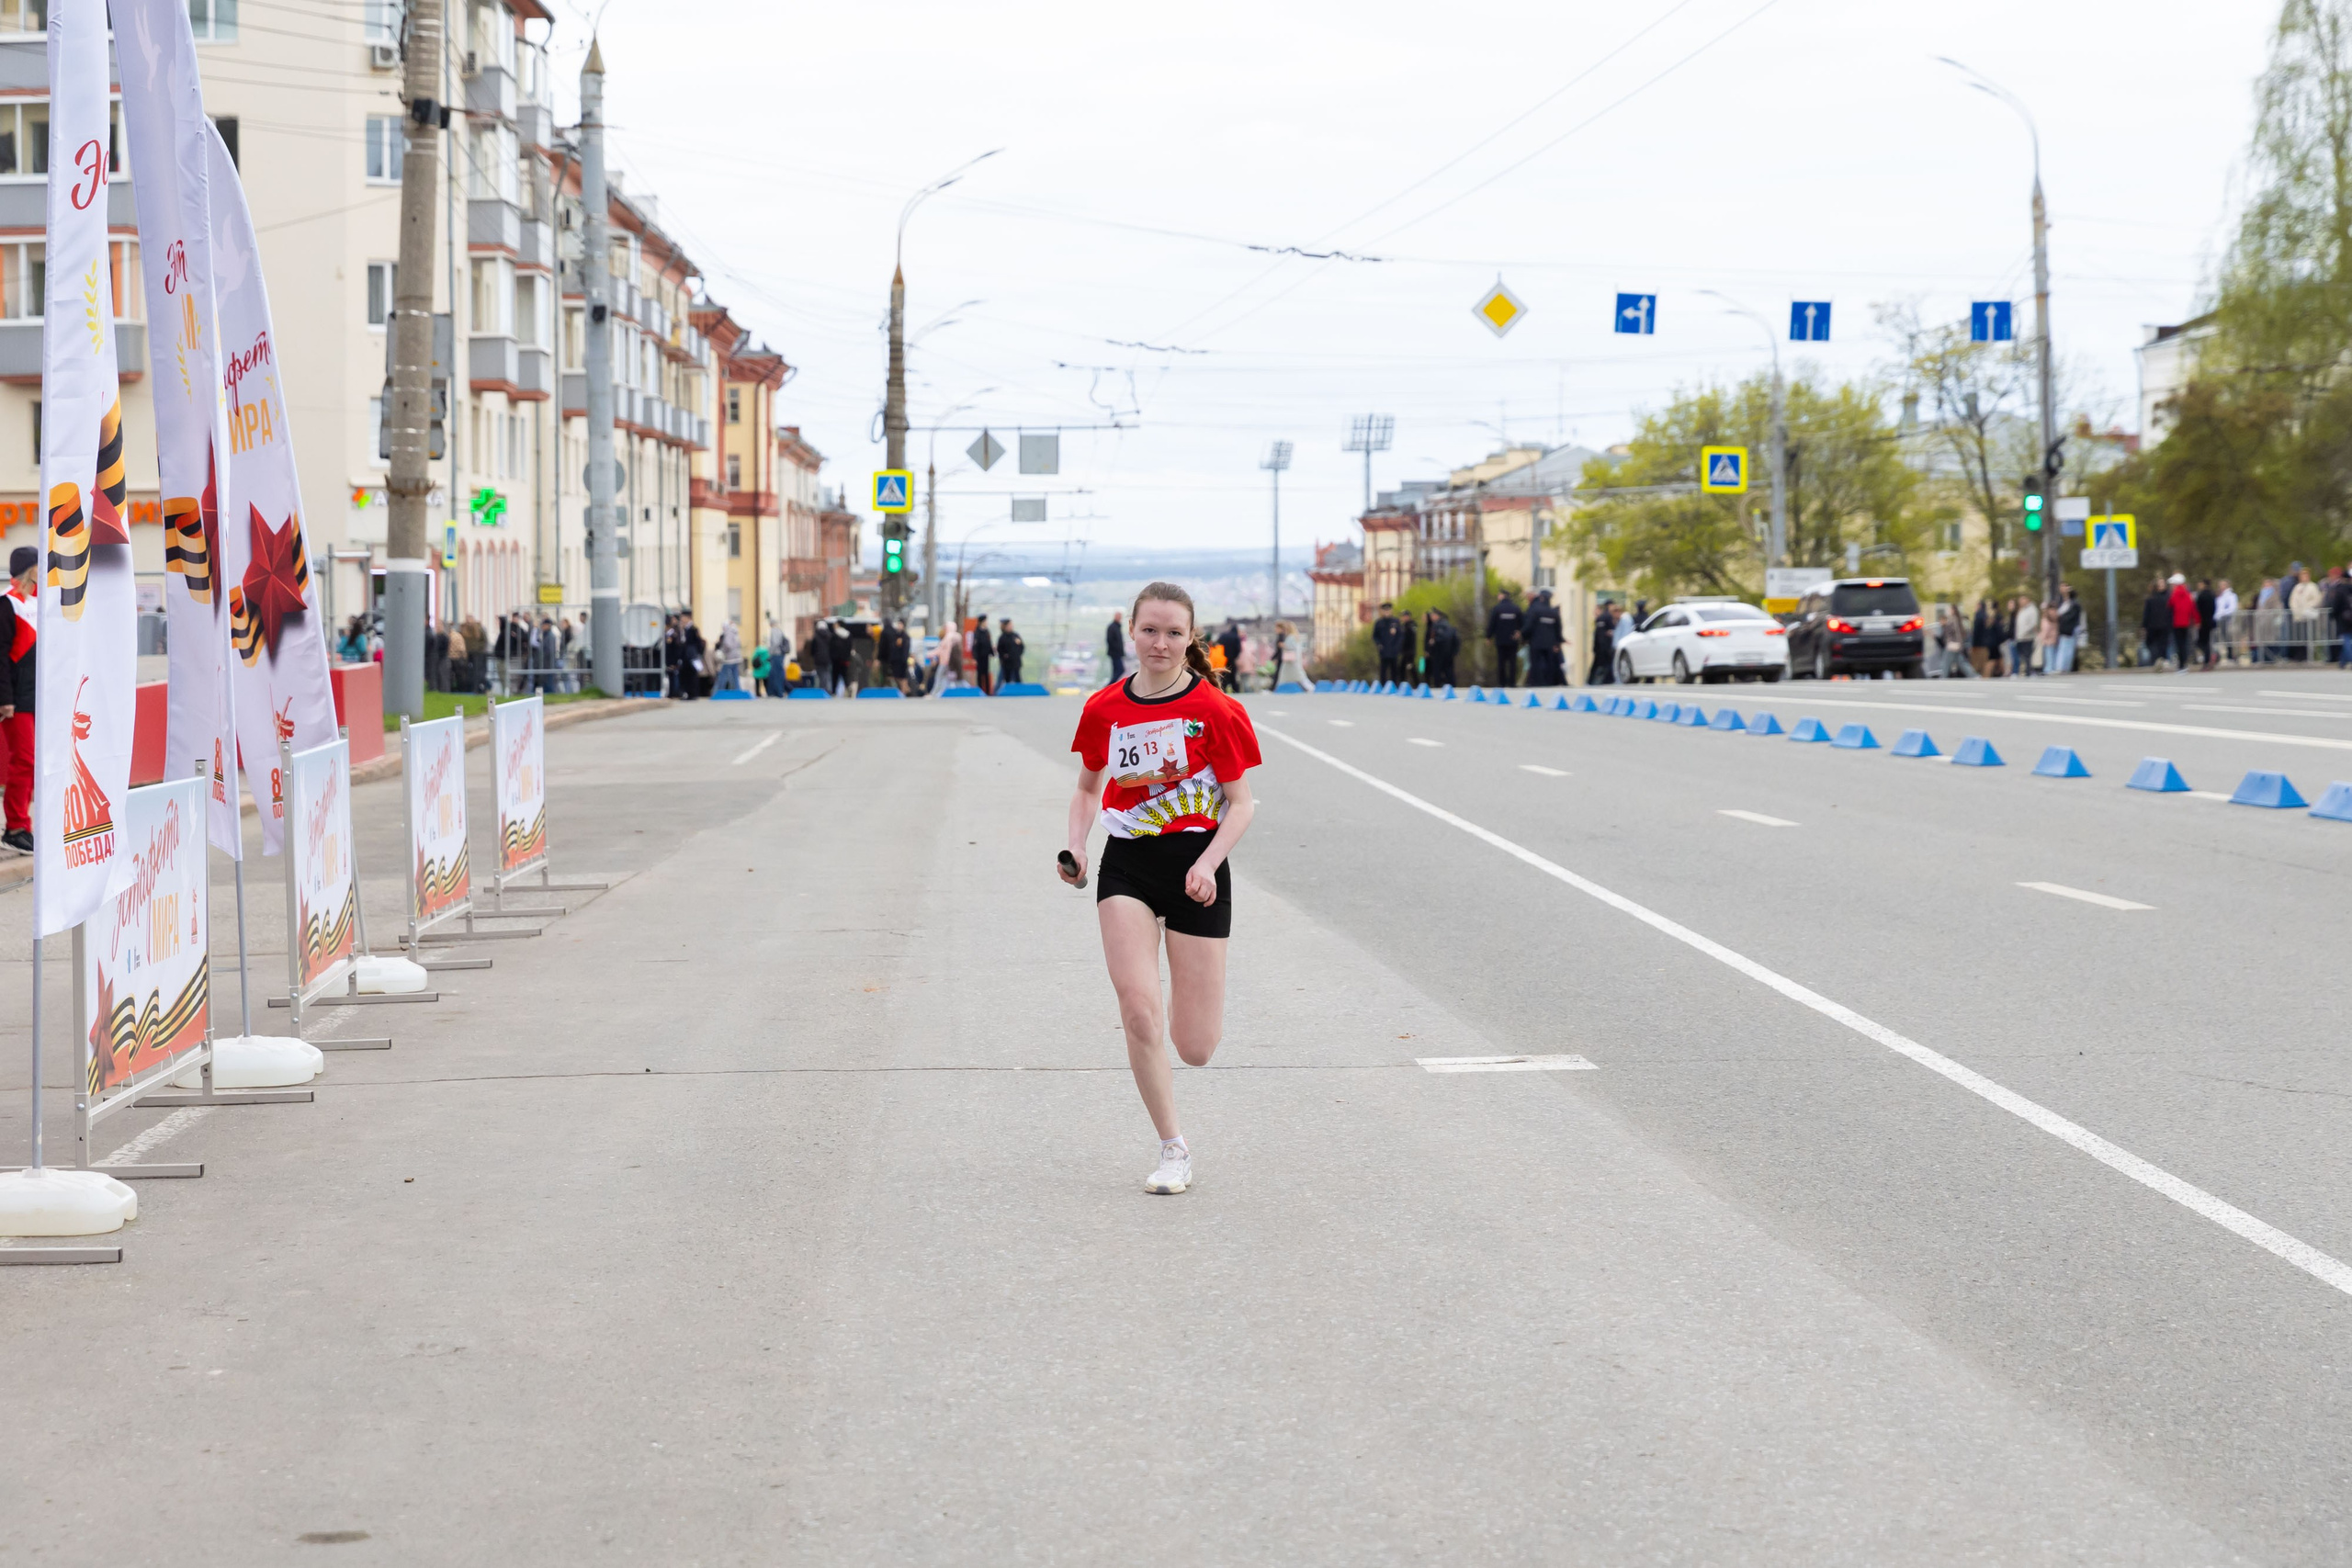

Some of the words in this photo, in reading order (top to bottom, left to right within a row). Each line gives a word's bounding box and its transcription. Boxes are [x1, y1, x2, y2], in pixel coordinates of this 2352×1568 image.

[228, 397, 273, 455] ИРА
[1119, 746, 1140, 768] 26
[1143, 741, 1159, 755] 13
[63, 784, 85, 835] 80
[64, 831, 115, 870] ПОБЕДА!
[152, 892, 180, 964] МИРА
